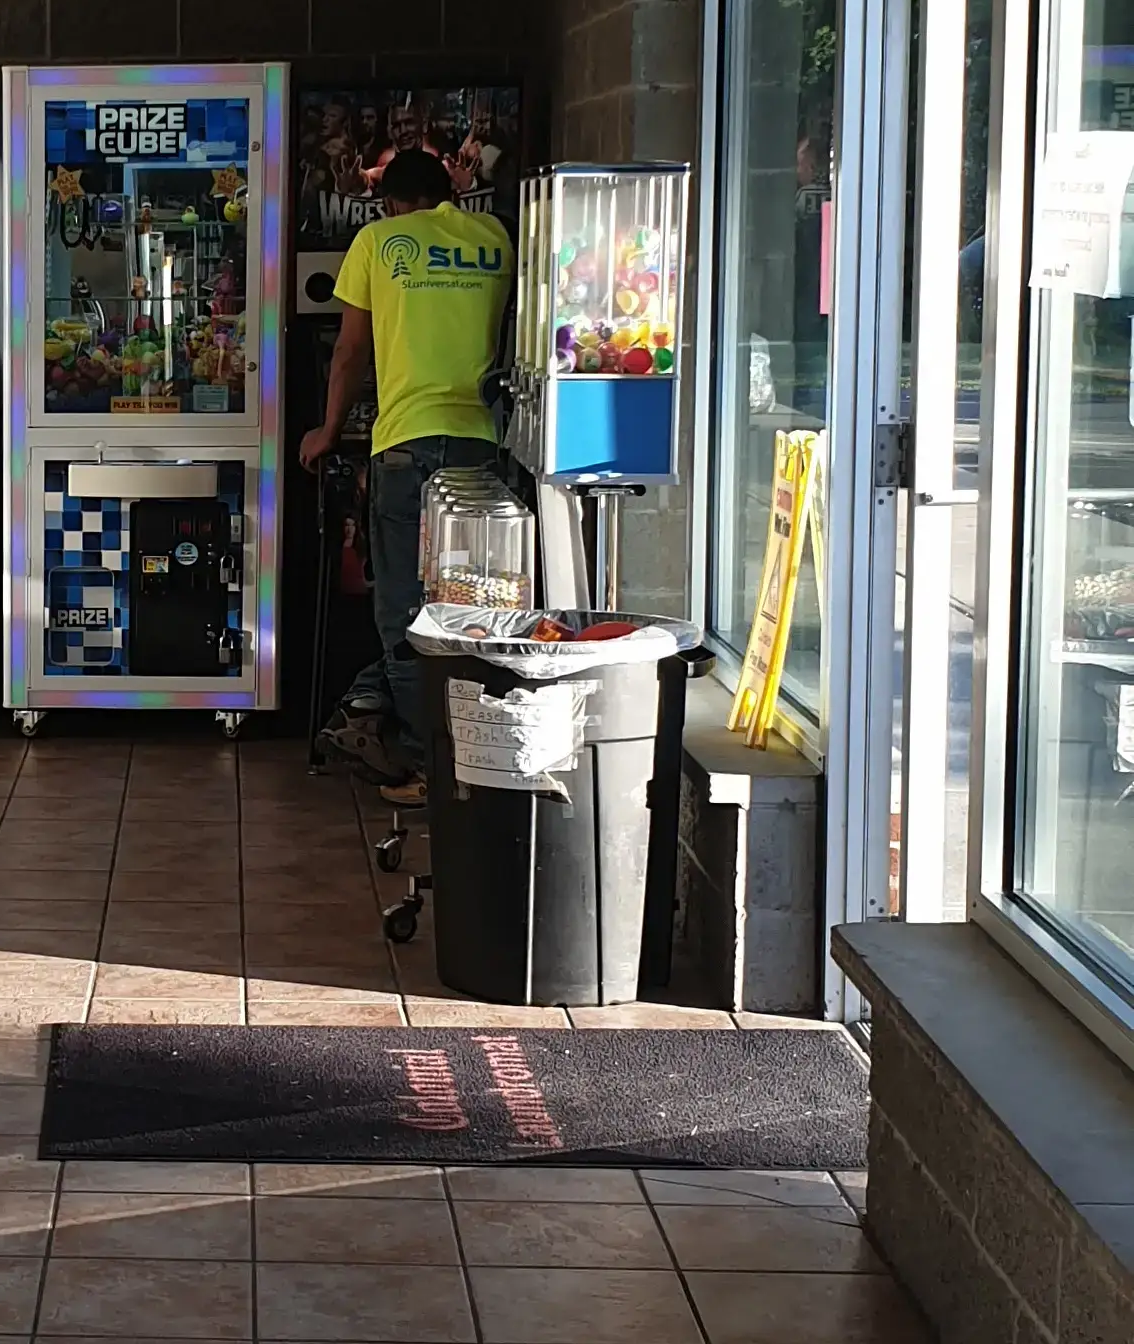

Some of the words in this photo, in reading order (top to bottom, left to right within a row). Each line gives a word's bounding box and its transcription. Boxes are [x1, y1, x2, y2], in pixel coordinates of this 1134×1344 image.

[99, 107, 185, 130] PRIZE
[99, 131, 177, 154] CUBE
[427, 245, 502, 270] SLU
[57, 609, 106, 625] PRIZE
[470, 1034, 565, 1149] Laundromat
